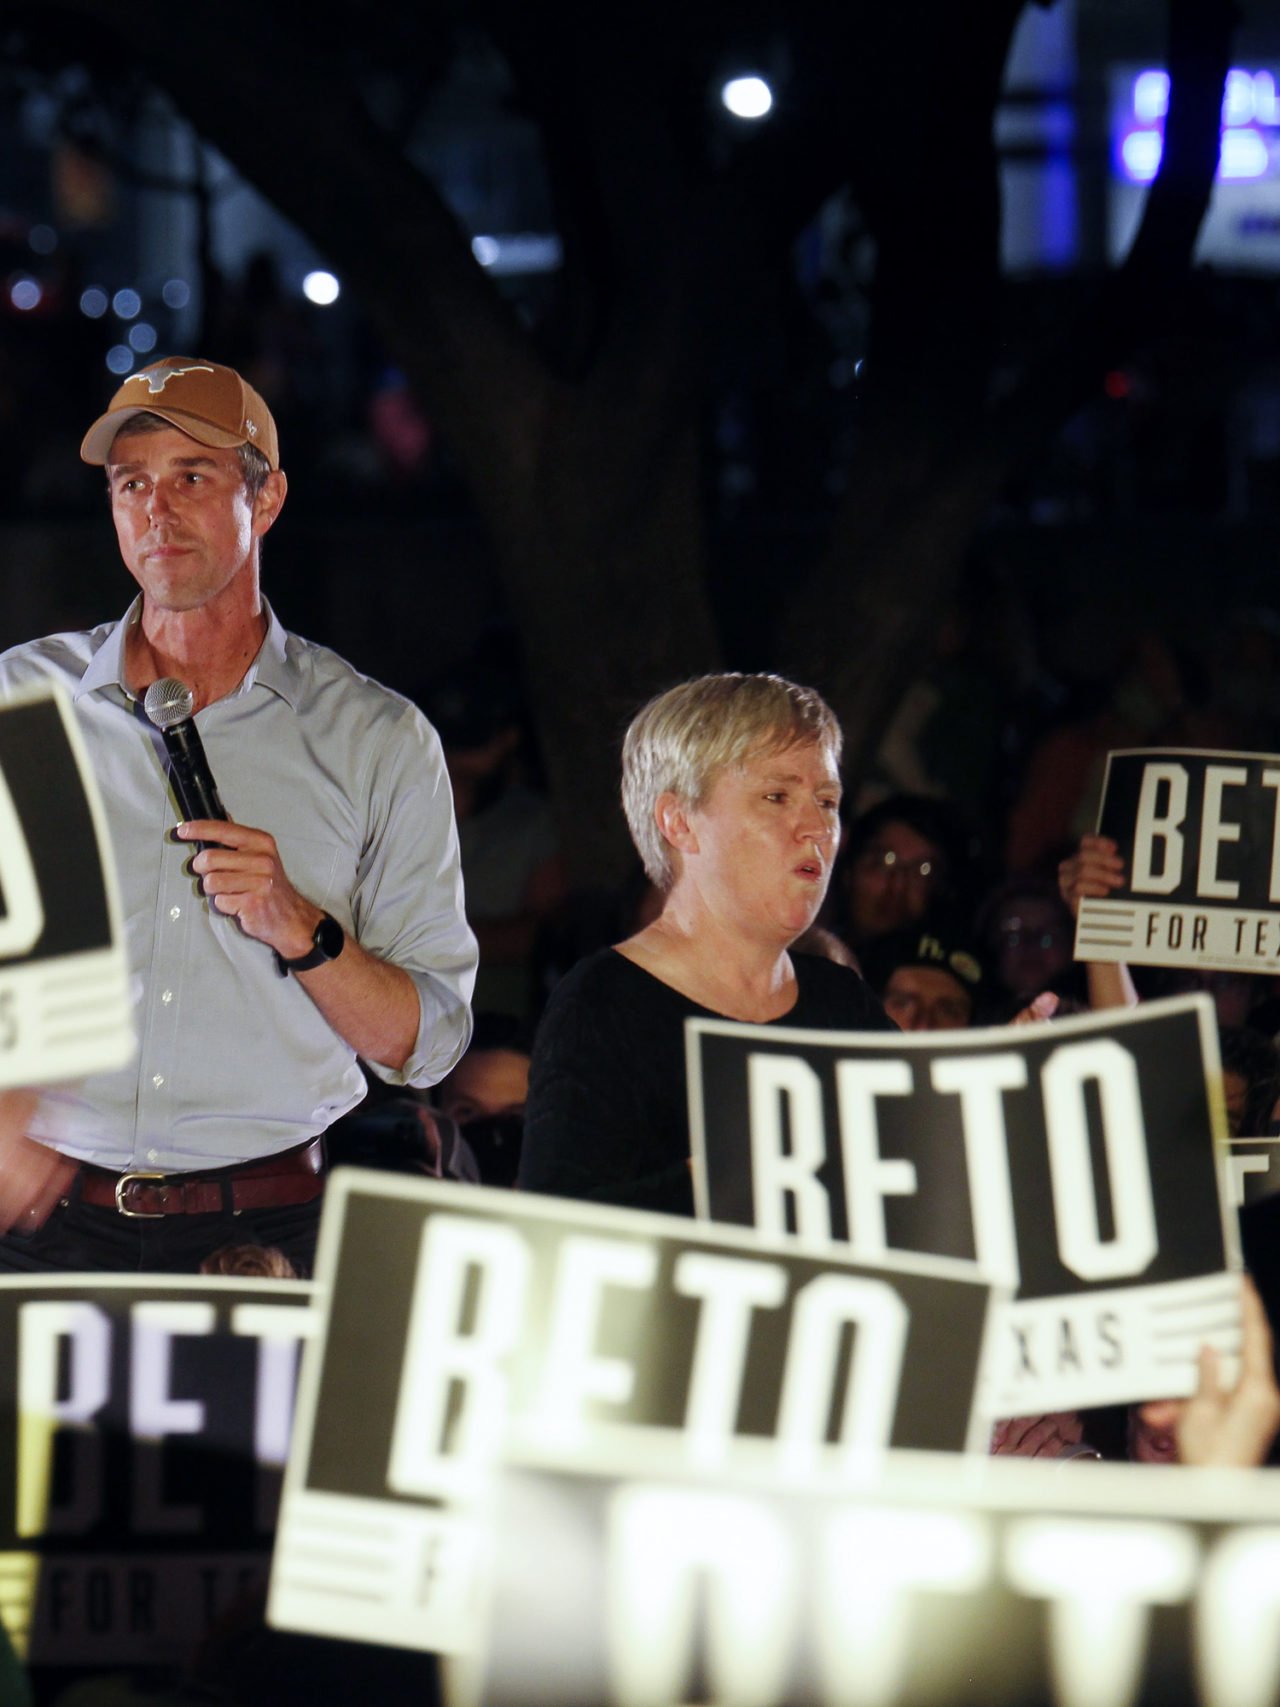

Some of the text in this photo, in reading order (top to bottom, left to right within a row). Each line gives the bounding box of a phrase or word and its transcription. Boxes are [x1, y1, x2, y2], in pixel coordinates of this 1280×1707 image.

[1146, 911, 1208, 952] FOR
[17, 1301, 315, 1537] BET
[388, 1213, 910, 1500] BETO
[1010, 1308, 1123, 1380] XAS
